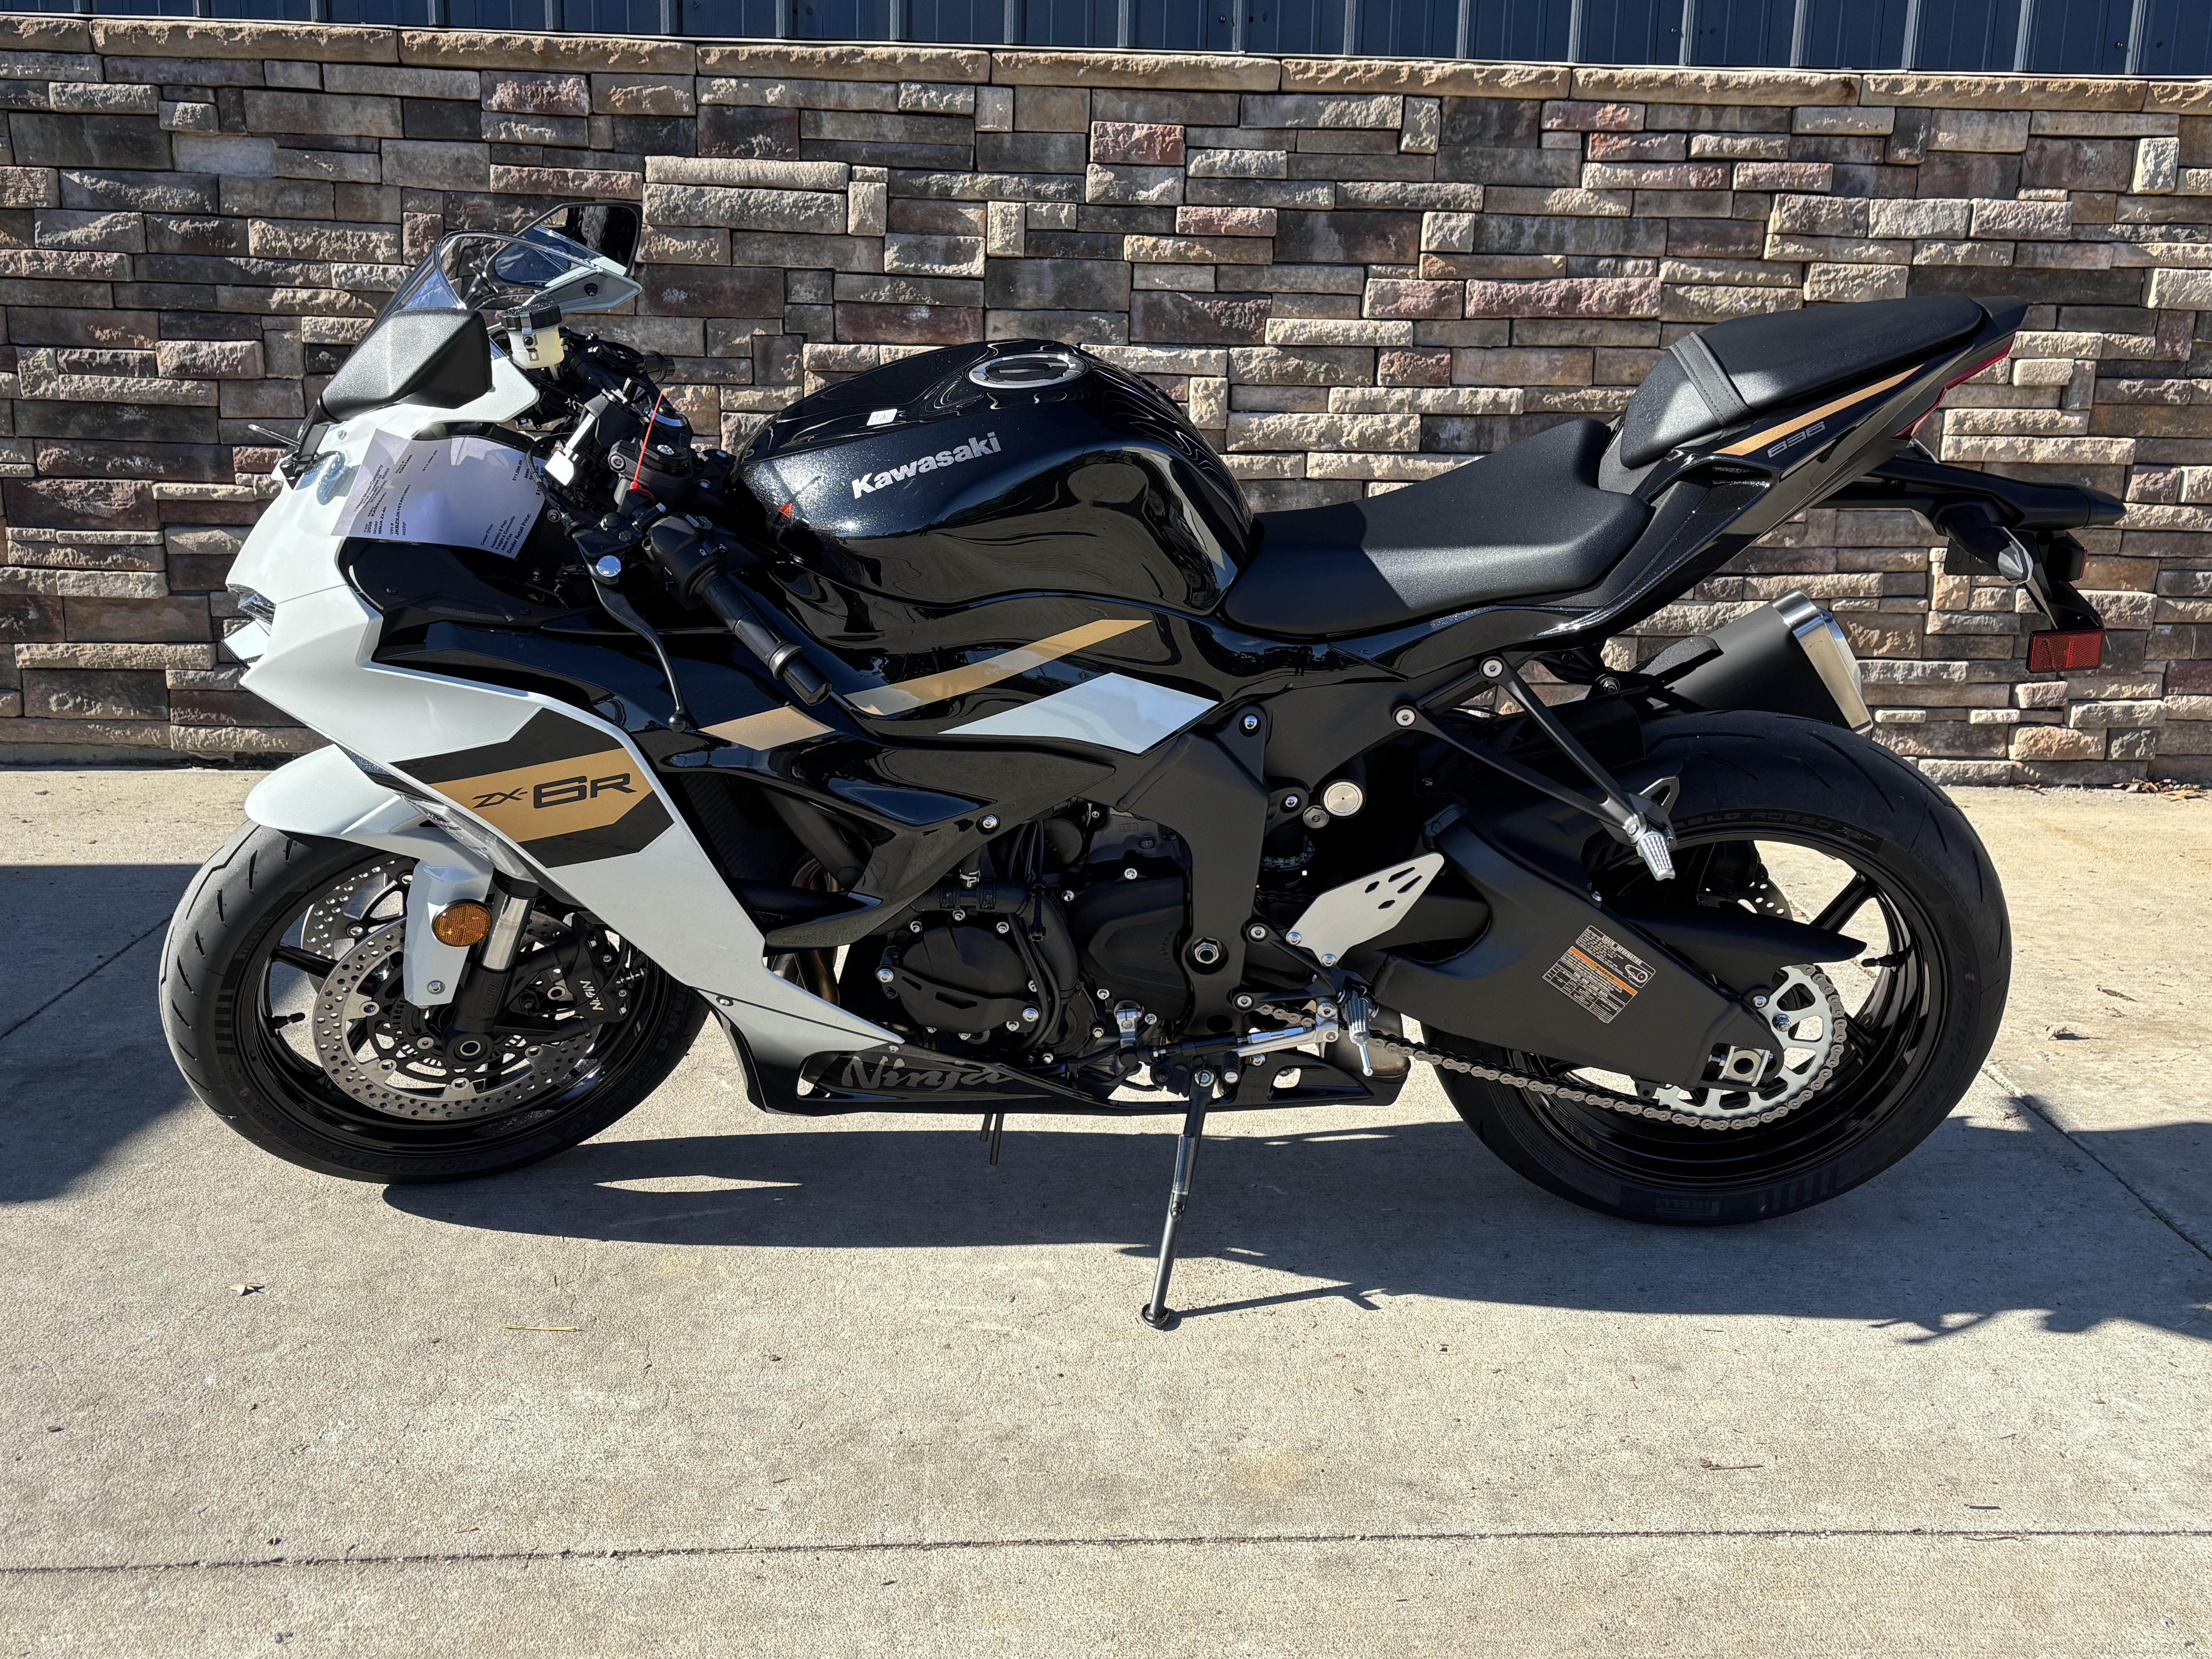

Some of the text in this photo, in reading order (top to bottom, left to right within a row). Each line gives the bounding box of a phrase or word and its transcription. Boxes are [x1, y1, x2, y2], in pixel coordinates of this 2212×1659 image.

[1767, 421, 1826, 458] 636
[370, 464, 383, 485] Company
[852, 431, 1002, 499] Kawasaki
[507, 539, 517, 554] Dealer
[515, 526, 524, 539] Retail
[471, 773, 638, 809] ZX-6R
[1673, 812, 1741, 831] ABLO
[1751, 812, 1833, 829] ROSSO
[1602, 935, 1642, 965] CHAIN INFORMATION
[483, 978, 501, 1015] SHOWA
[841, 1055, 1014, 1093] Ninja
